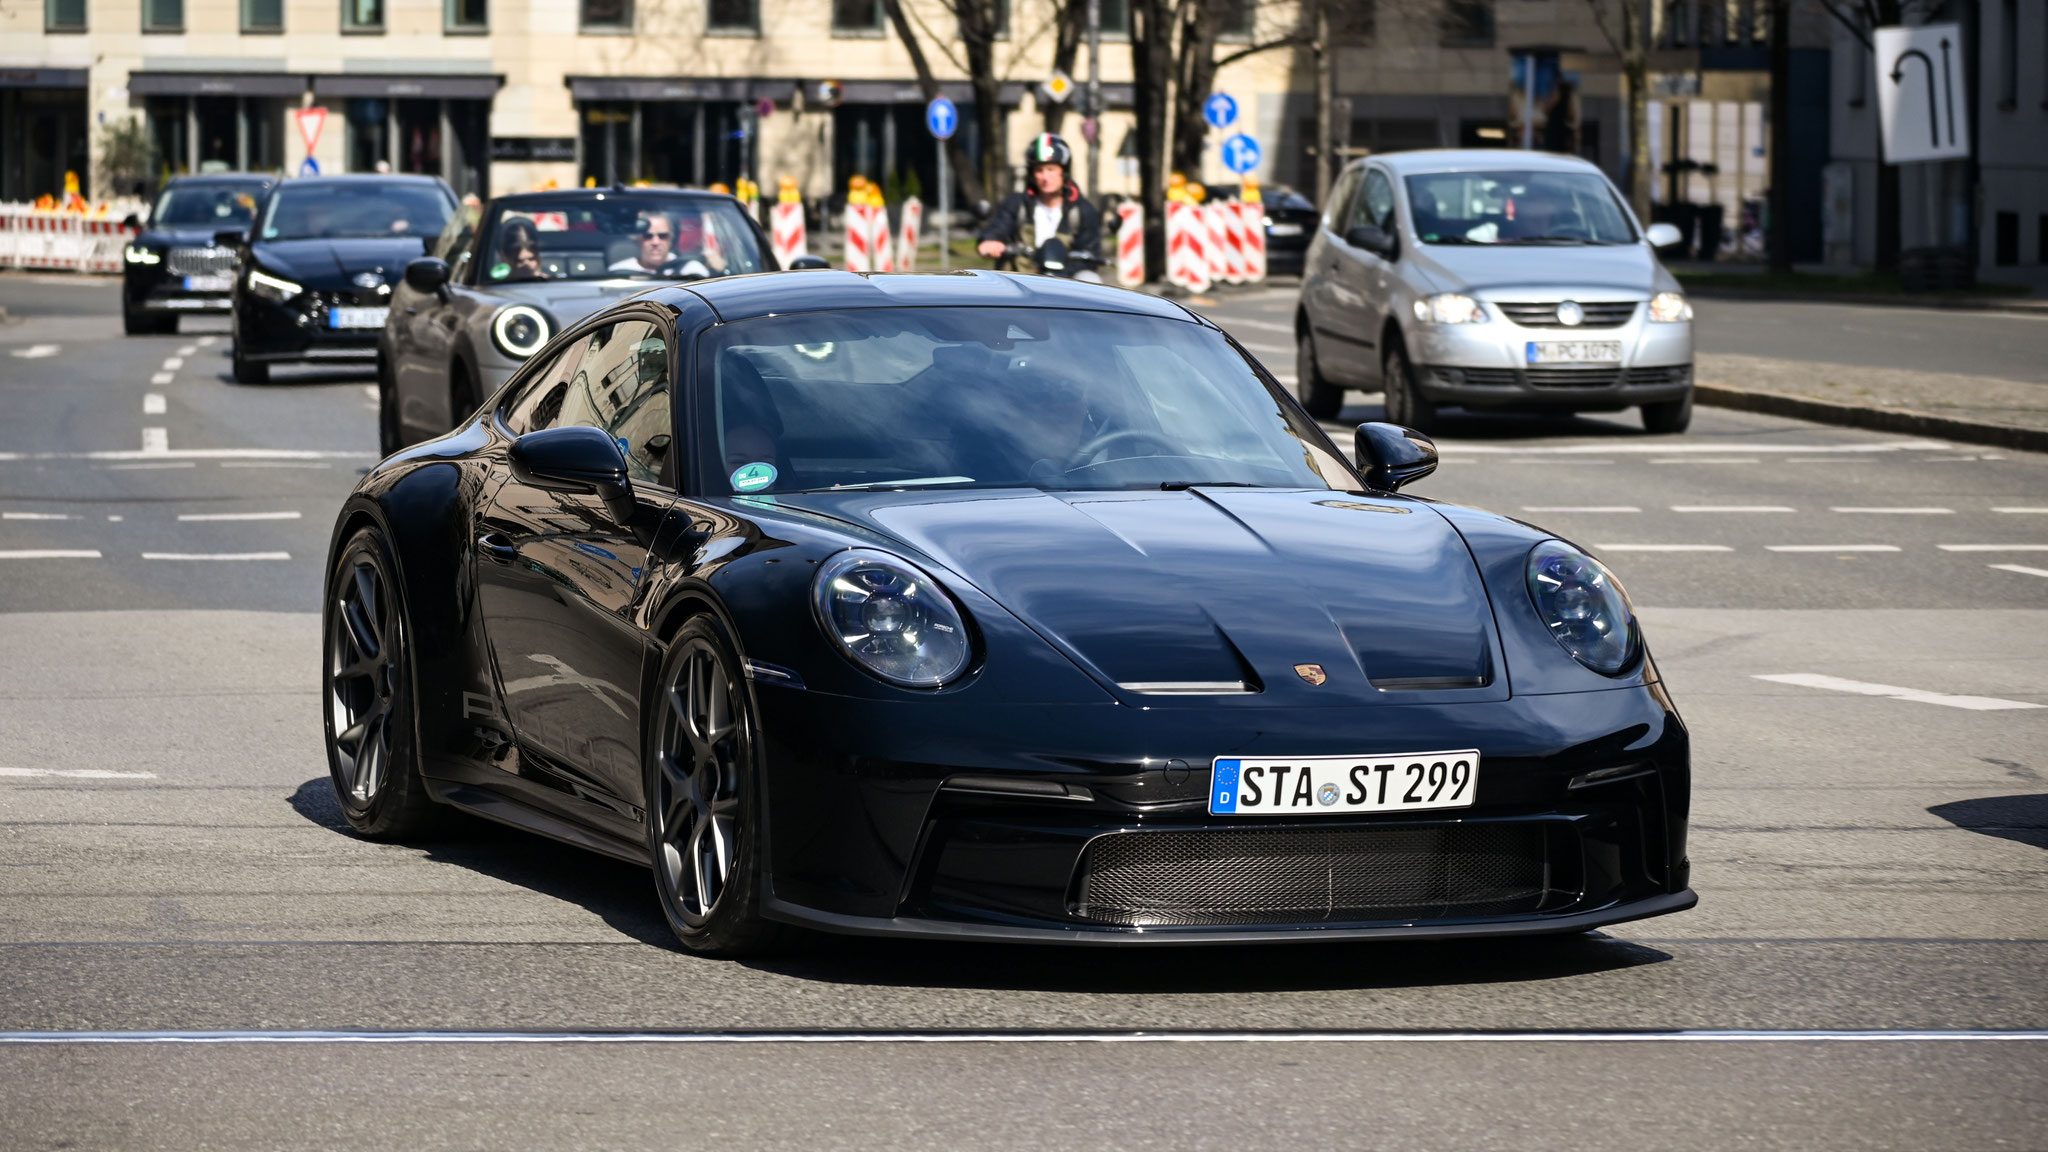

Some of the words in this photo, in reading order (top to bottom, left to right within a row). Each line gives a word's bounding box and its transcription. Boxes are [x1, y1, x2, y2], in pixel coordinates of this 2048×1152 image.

[748, 466, 759, 477] 4
[1240, 766, 1313, 806] STA
[1346, 764, 1395, 805] ST
[1402, 759, 1471, 804] 299
[1219, 791, 1230, 804] D
